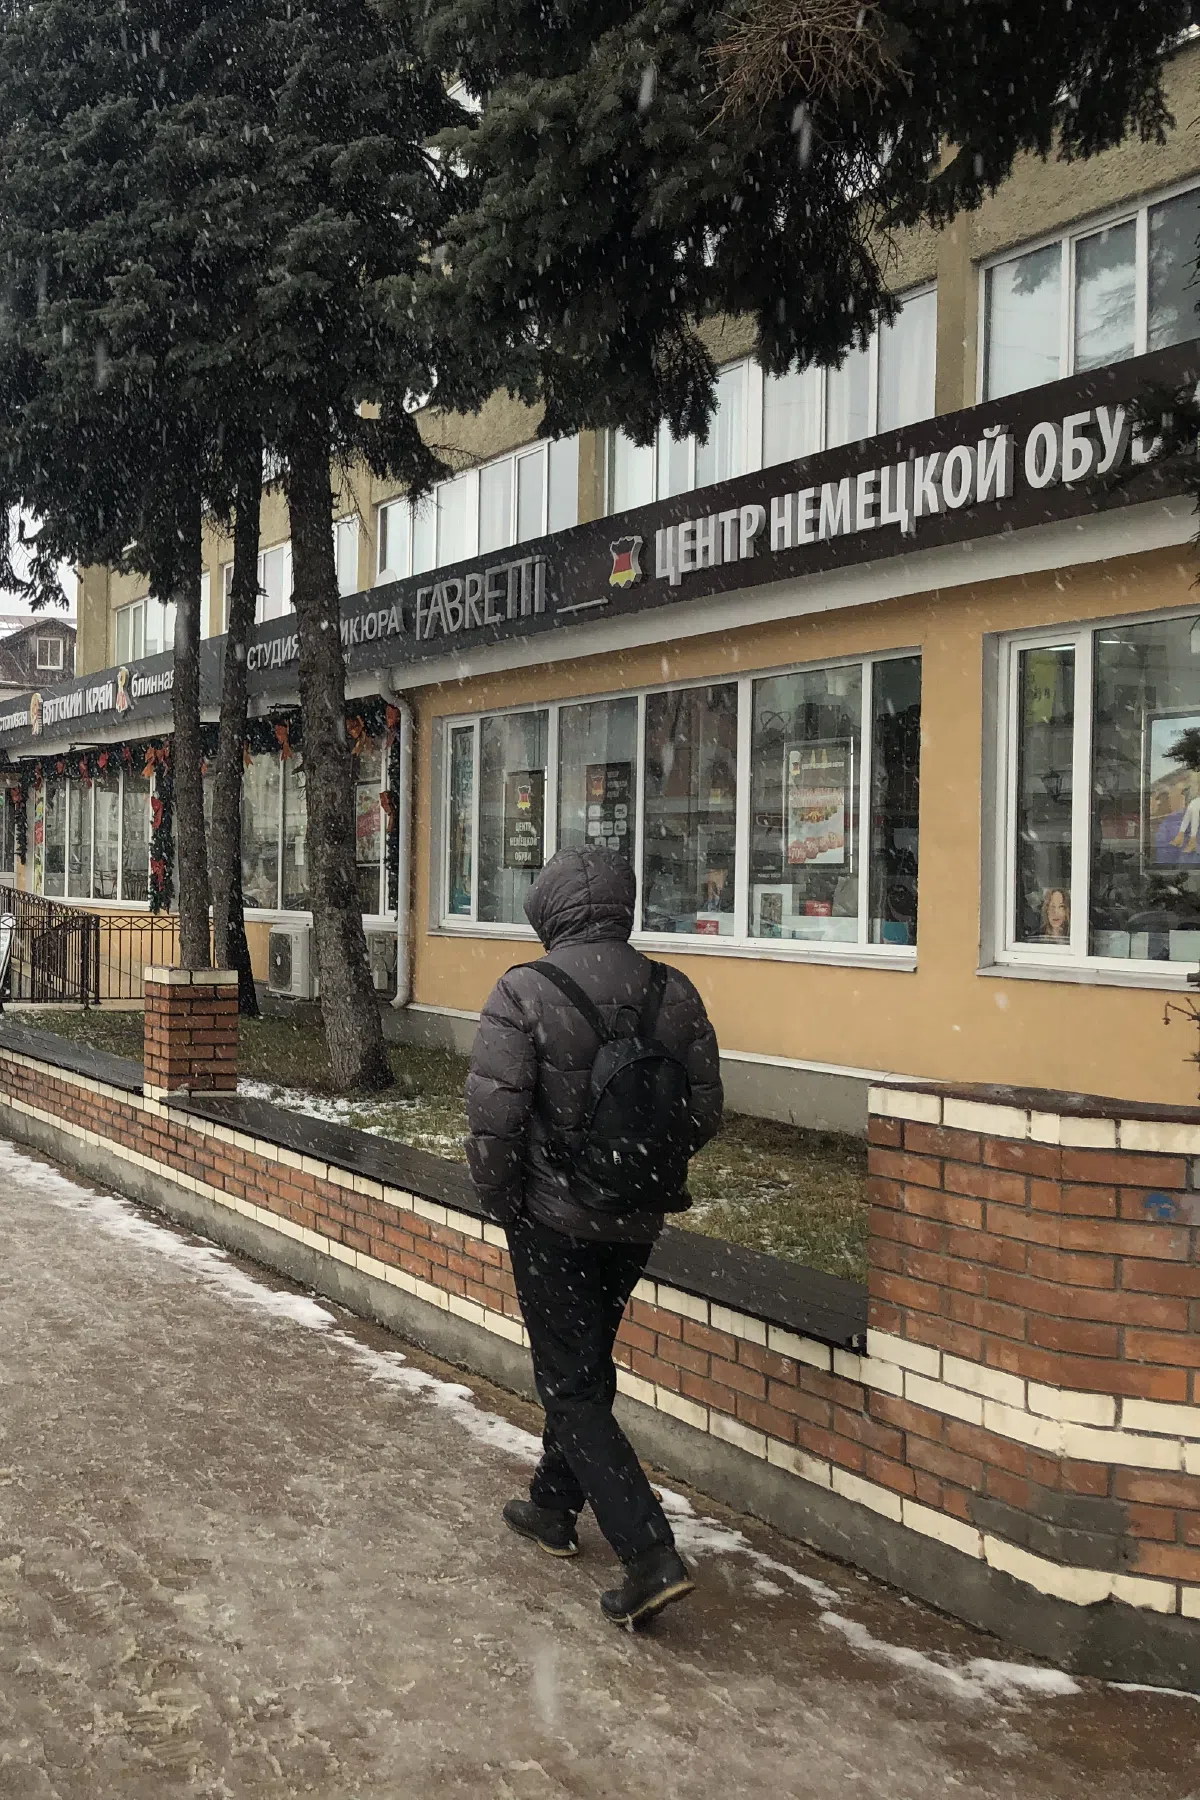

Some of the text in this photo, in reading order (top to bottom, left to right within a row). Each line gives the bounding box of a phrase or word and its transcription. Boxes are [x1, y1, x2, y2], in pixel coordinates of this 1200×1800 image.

[655, 404, 1174, 586] ЦЕНТР НЕМЕЦКОЙ ОБУ
[416, 555, 546, 640] FABRETTI
[247, 605, 400, 671] СТУДИЯ ИКЮРА
[85, 682, 113, 713] КРАЙ
[132, 669, 174, 698] блинная
[515, 822, 532, 832] ЦЕНТР
